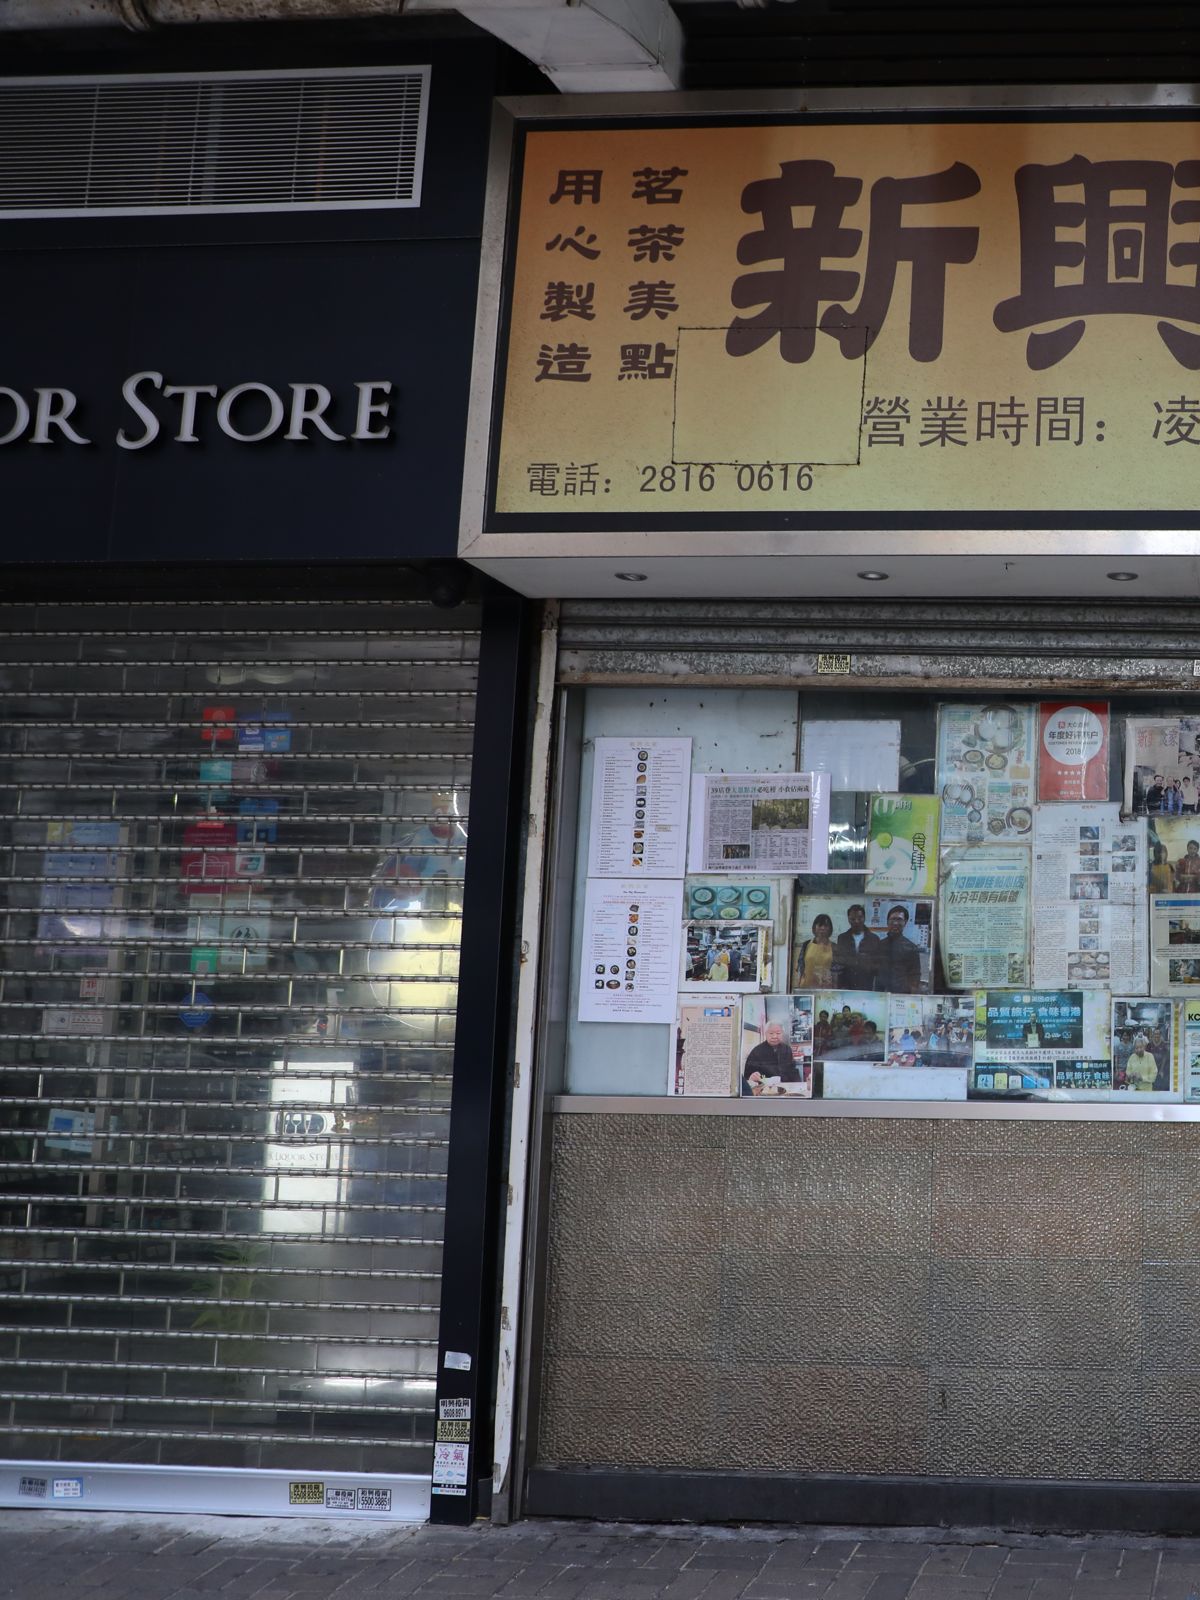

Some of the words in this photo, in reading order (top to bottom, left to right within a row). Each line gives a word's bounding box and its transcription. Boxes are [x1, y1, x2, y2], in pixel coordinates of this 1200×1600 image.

[535, 169, 602, 383] 用心製造
[617, 166, 689, 383] 茗茶美點
[116, 370, 393, 450] STORE
[640, 464, 716, 493] 2816
[737, 464, 813, 492] 0616
